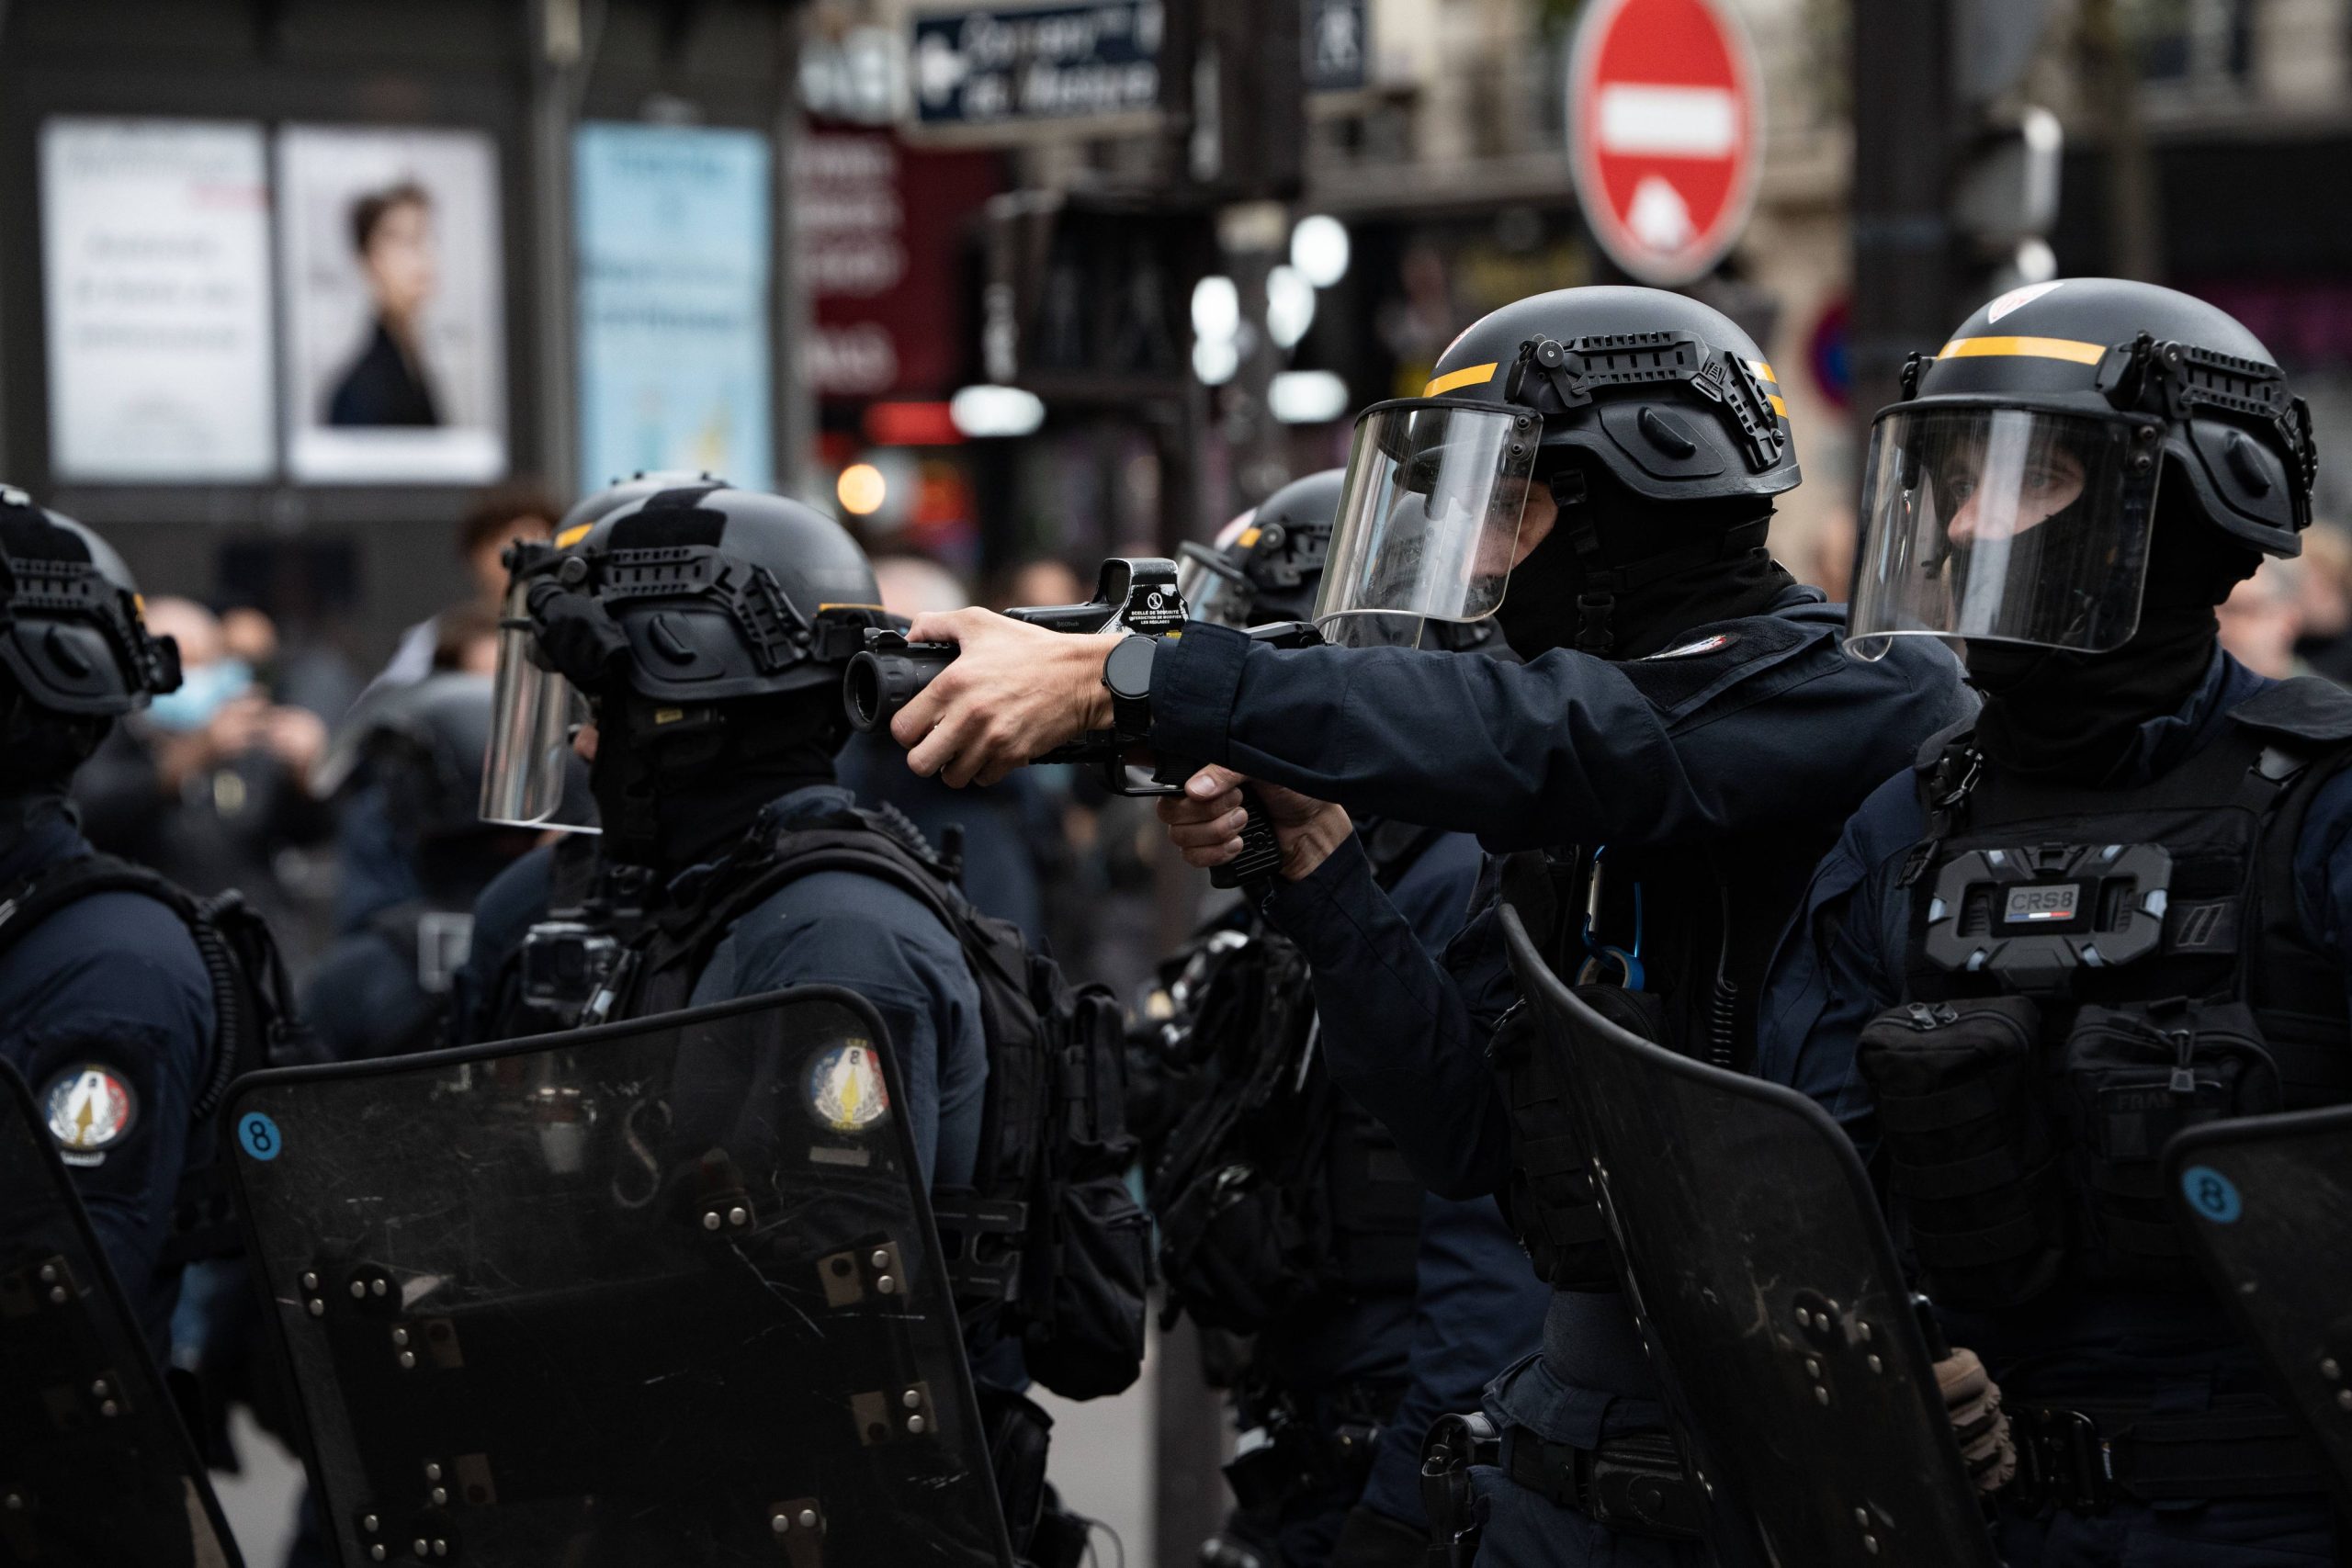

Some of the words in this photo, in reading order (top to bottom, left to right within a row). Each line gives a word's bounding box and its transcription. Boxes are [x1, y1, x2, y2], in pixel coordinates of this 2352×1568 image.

[2011, 890, 2074, 910] CRS8
[249, 1121, 272, 1152] 8
[2200, 1177, 2225, 1213] 8
